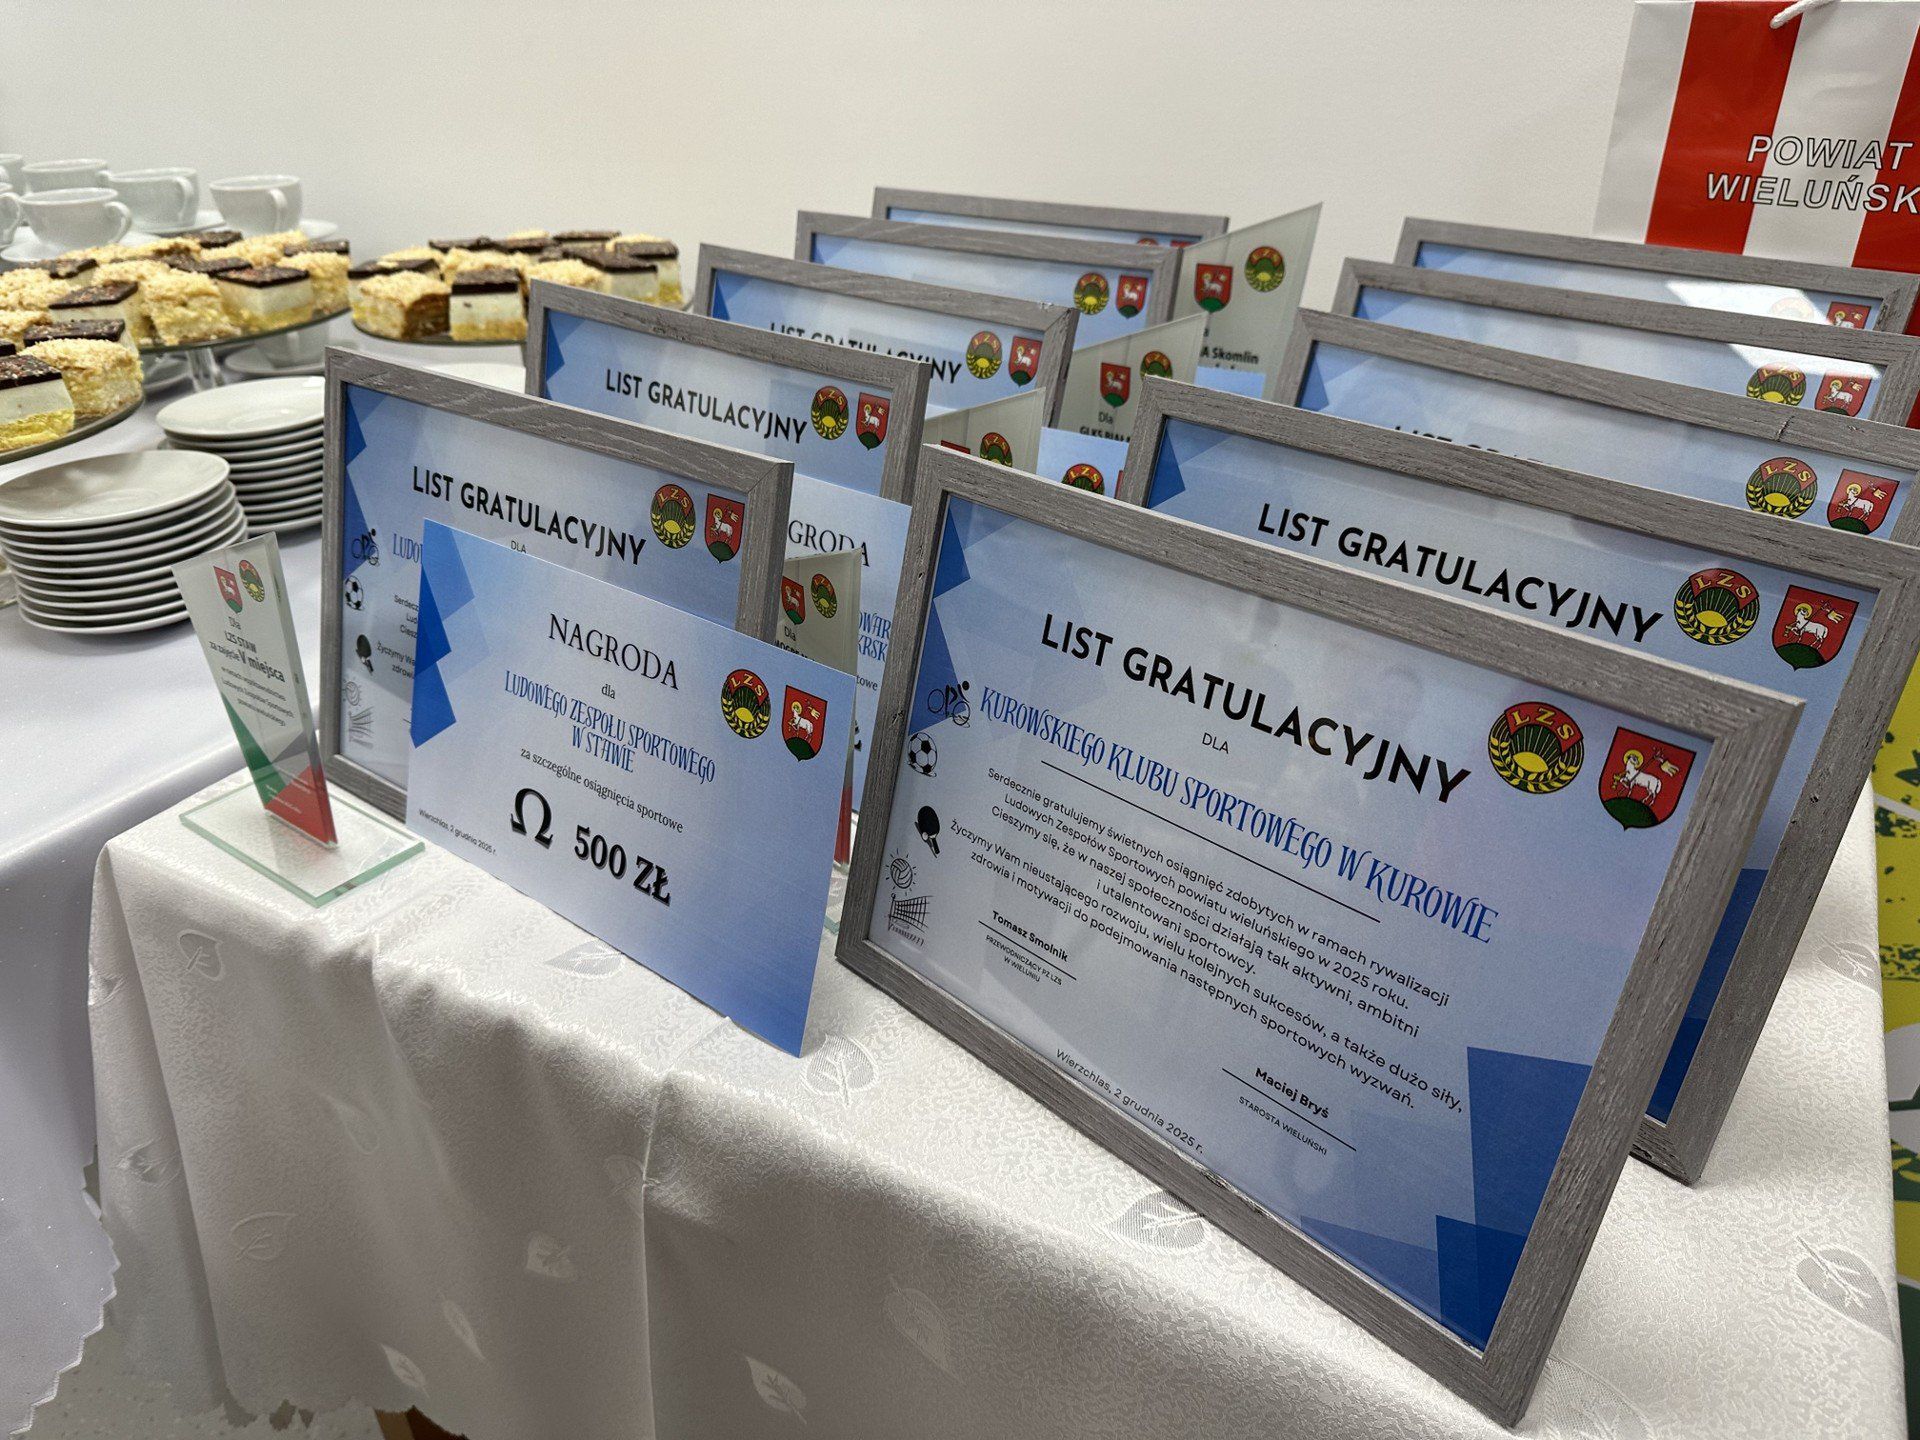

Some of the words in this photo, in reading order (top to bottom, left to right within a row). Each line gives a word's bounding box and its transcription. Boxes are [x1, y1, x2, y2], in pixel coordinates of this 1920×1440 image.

[1746, 134, 1914, 170] POWIAT
[1212, 347, 1260, 365] Skomlin
[606, 369, 642, 399] LIST
[648, 381, 808, 444] GRATULACYJNY
[818, 388, 845, 406] LZS
[1098, 411, 1113, 424] Dla
[1070, 466, 1099, 483] LZS
[1764, 460, 1812, 483] LZS
[413, 466, 453, 501] LIST
[461, 482, 646, 565] GRATULACYJNY
[658, 488, 690, 508] LZS
[393, 533, 422, 563] LUDO
[510, 540, 527, 554] DLA
[788, 520, 870, 567] GRODA
[1257, 503, 1330, 547] LIST
[1338, 527, 1664, 643] GRATULACYJNY
[1695, 572, 1752, 600] LZS
[394, 595, 419, 611] Serdecz
[400, 624, 417, 638] Ciesz
[784, 626, 796, 641] Dla
[238, 649, 246, 664] V
[248, 657, 285, 682] miejsca
[549, 613, 679, 690] NAGRODA
[601, 684, 616, 699] dla
[730, 673, 765, 696] LZS
[856, 674, 878, 691] towe
[1041, 613, 1113, 667] LIST
[1123, 647, 1472, 803] GRATULACYJNY
[1511, 707, 1575, 741] LZS
[505, 671, 567, 718] LUDOWEGO
[570, 698, 626, 742] ZESPOŁU
[628, 724, 716, 785] SPORTOWEGO
[1202, 732, 1229, 754] DLA
[572, 726, 587, 748] W
[586, 732, 636, 773] STAWIE
[520, 749, 531, 759] za
[532, 753, 582, 783] szczególne
[583, 778, 635, 810] osiągnięcia
[637, 803, 683, 833] sportowe
[980, 686, 1105, 767] KUROWSKIEGO
[1107, 743, 1180, 798] KLUBU
[1180, 776, 1332, 869] SPORTOWEGO
[1337, 845, 1372, 882] W
[1365, 858, 1499, 943] KUROWIE
[455, 829, 477, 846] grudnia
[478, 840, 493, 853] 2025
[574, 824, 627, 879] 500
[633, 855, 671, 907] ZŁ
[988, 768, 1041, 801] Serdecznie
[1043, 796, 1106, 835] gratulujemy
[1107, 826, 1163, 863] świetnych
[1166, 858, 1224, 893] osiągnięć
[1226, 887, 1294, 929] zdobytych
[1298, 923, 1310, 936] w
[1312, 931, 1367, 965] ramach
[1370, 960, 1450, 1007] rywalizacji
[1004, 793, 1054, 827] Ludowych
[1056, 820, 1106, 852] Zespołów
[1109, 847, 1175, 888] Sportowych
[1177, 884, 1227, 915] powiatu
[1230, 909, 1314, 960] wieluńskiego
[1319, 956, 1330, 968] w
[1333, 962, 1368, 988] 2025
[1372, 983, 1409, 1010] roku.
[991, 805, 1041, 840] Cieszymy
[1042, 833, 1060, 851] się,
[1062, 841, 1076, 857] że
[1078, 852, 1088, 863] w
[1089, 857, 1126, 884] naszej
[1127, 878, 1211, 927] społeczności
[1212, 922, 1263, 958] działają
[1267, 950, 1290, 970] tak
[1292, 965, 1354, 1005] aktywni,
[1357, 999, 1420, 1038] ambitni
[992, 910, 1028, 938] Tomasz
[1028, 932, 1068, 962] Smolnik
[1096, 879, 1101, 890] i
[1103, 885, 1181, 933] utalentowani
[1183, 928, 1256, 975] sportowcy.
[950, 819, 993, 853] Życzymy
[994, 844, 1027, 867] Wam
[1023, 862, 1098, 909] nieustającego
[1101, 904, 1149, 939] rozwoju,
[1153, 932, 1185, 956] wielu
[1188, 950, 1250, 993] kolejnych
[1252, 988, 1327, 1037] sukcesów,
[1331, 1031, 1340, 1043] a
[1344, 1035, 1386, 1067] także
[1389, 1061, 1428, 1091] dużo
[1431, 1086, 1463, 1113] siły,
[970, 851, 1010, 879] zdrowia
[1012, 872, 1017, 882] i
[1016, 875, 1072, 914] motywacji
[1073, 908, 1088, 922] do
[1090, 918, 1177, 973] podejmowania
[1180, 968, 1257, 1019] następnych
[1260, 1013, 1346, 1069] sportowych
[1350, 1066, 1414, 1109] wyzwań.
[1004, 955, 1011, 964] W
[1011, 960, 1040, 982] WIELUNIU
[1041, 968, 1050, 978] PZ
[1050, 974, 1062, 985] LZS
[1056, 1048, 1112, 1093] Wierzchlas,
[1114, 1088, 1122, 1099] 2
[1122, 1095, 1165, 1127] grudnia
[1166, 1122, 1195, 1147] 2025
[1196, 1143, 1203, 1154] r.
[1255, 1067, 1298, 1102] Maciej
[1299, 1093, 1329, 1119] Bryś
[1239, 1096, 1280, 1127] STAROSTA
[1282, 1122, 1327, 1155] WIELUŃSKI
